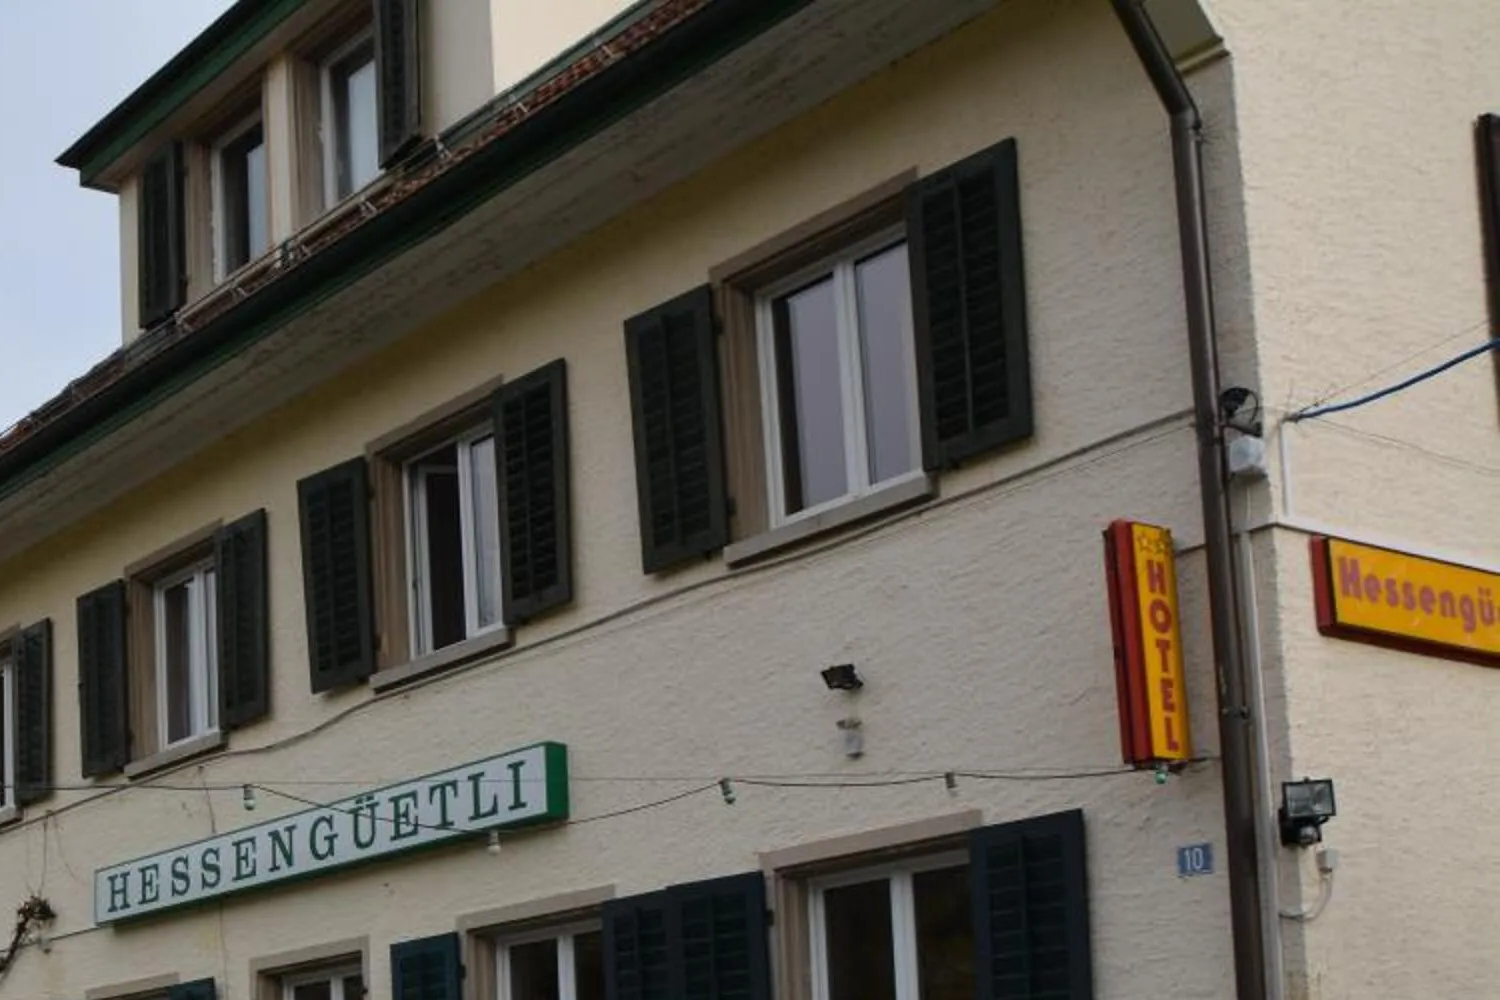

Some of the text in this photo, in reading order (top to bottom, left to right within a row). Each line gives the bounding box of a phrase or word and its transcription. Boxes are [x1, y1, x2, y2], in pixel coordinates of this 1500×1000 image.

[1337, 557, 1500, 634] Hessengü
[1146, 559, 1179, 753] HOTEL
[107, 760, 526, 913] HESSENGÜETLI
[1184, 847, 1204, 870] 10
